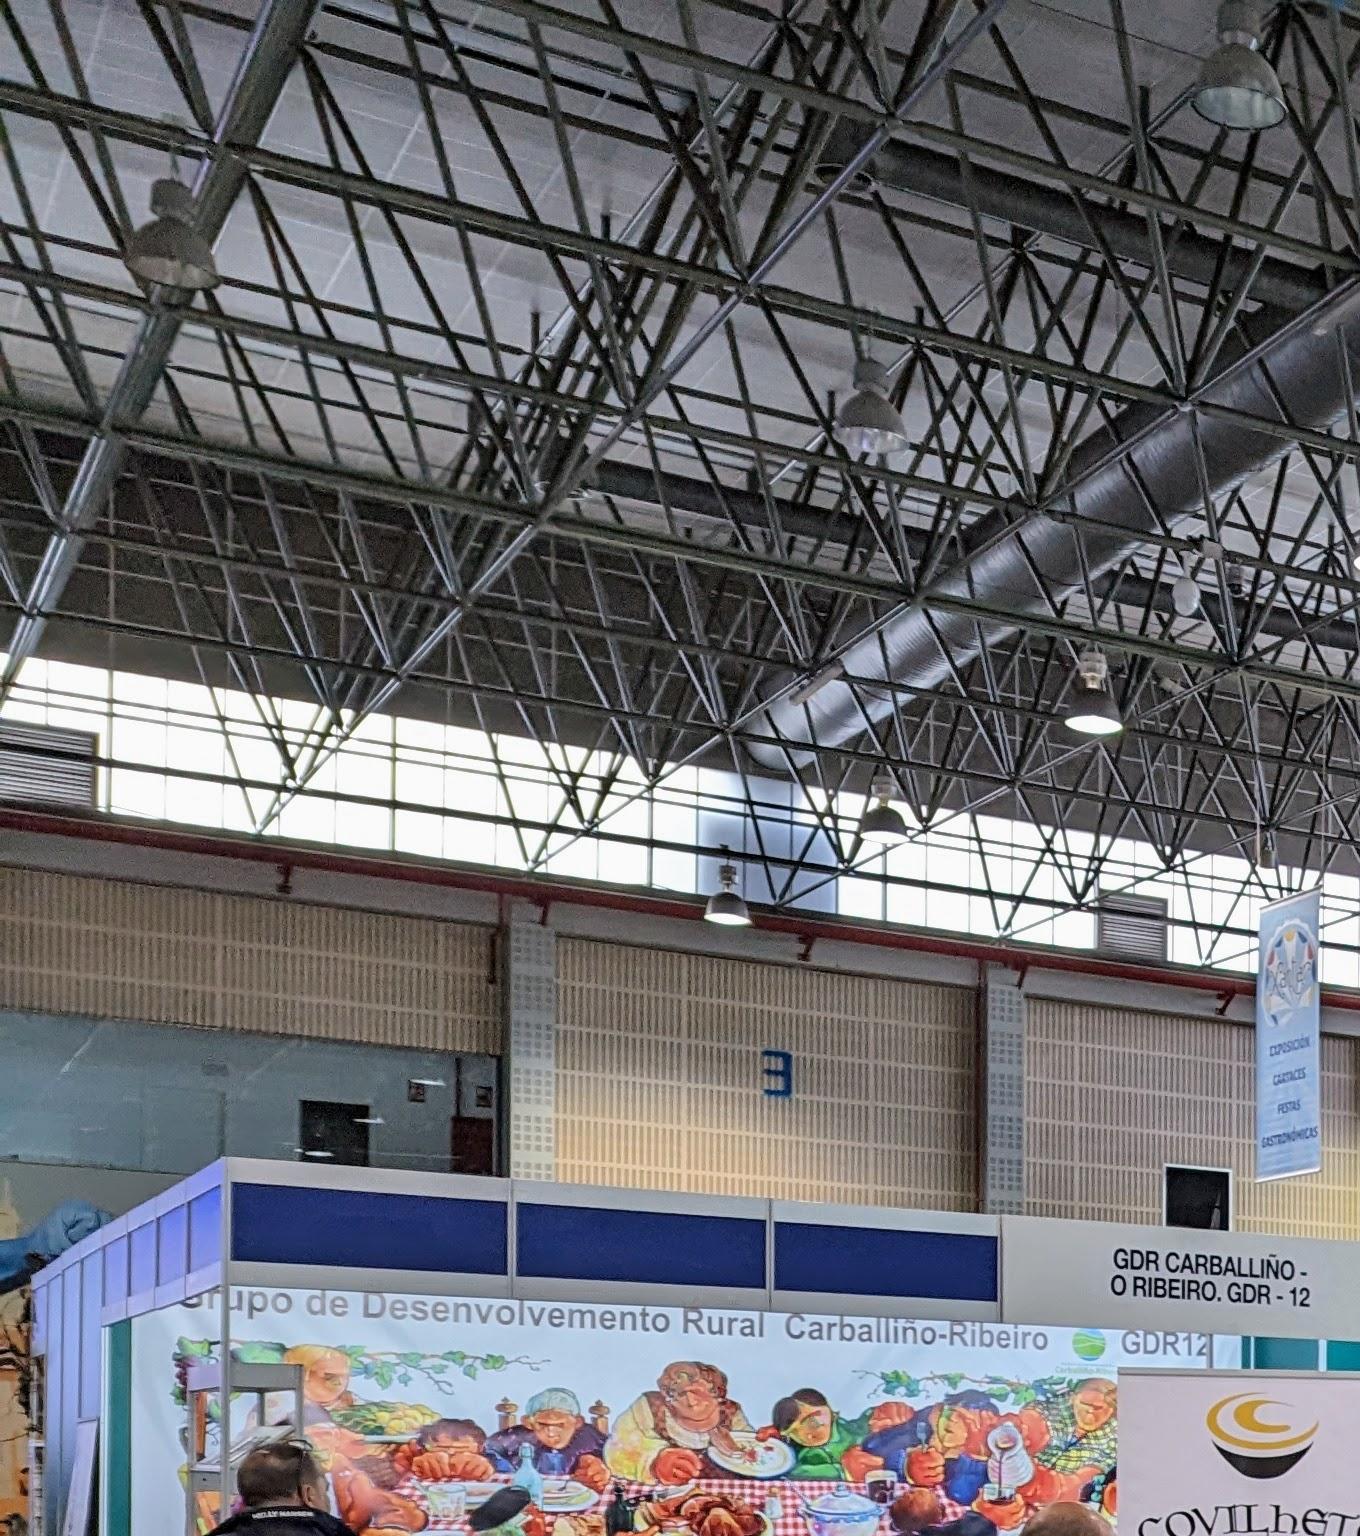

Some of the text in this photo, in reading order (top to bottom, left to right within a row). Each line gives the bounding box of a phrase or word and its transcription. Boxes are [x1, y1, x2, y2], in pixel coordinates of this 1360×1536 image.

[1113, 1248, 1159, 1271] GDR
[1166, 1252, 1295, 1280] CARBALLIÑO
[1111, 1275, 1126, 1296] O
[1133, 1277, 1221, 1302] RIBEIRO.
[1227, 1282, 1271, 1305] GDR
[1290, 1287, 1310, 1307] 12
[306, 1290, 349, 1316] de
[362, 1291, 671, 1333] Desenvolvemento
[682, 1307, 764, 1338] Rural
[785, 1313, 1048, 1351] Carballiño-Ribeiro
[1122, 1330, 1208, 1357] GDR12
